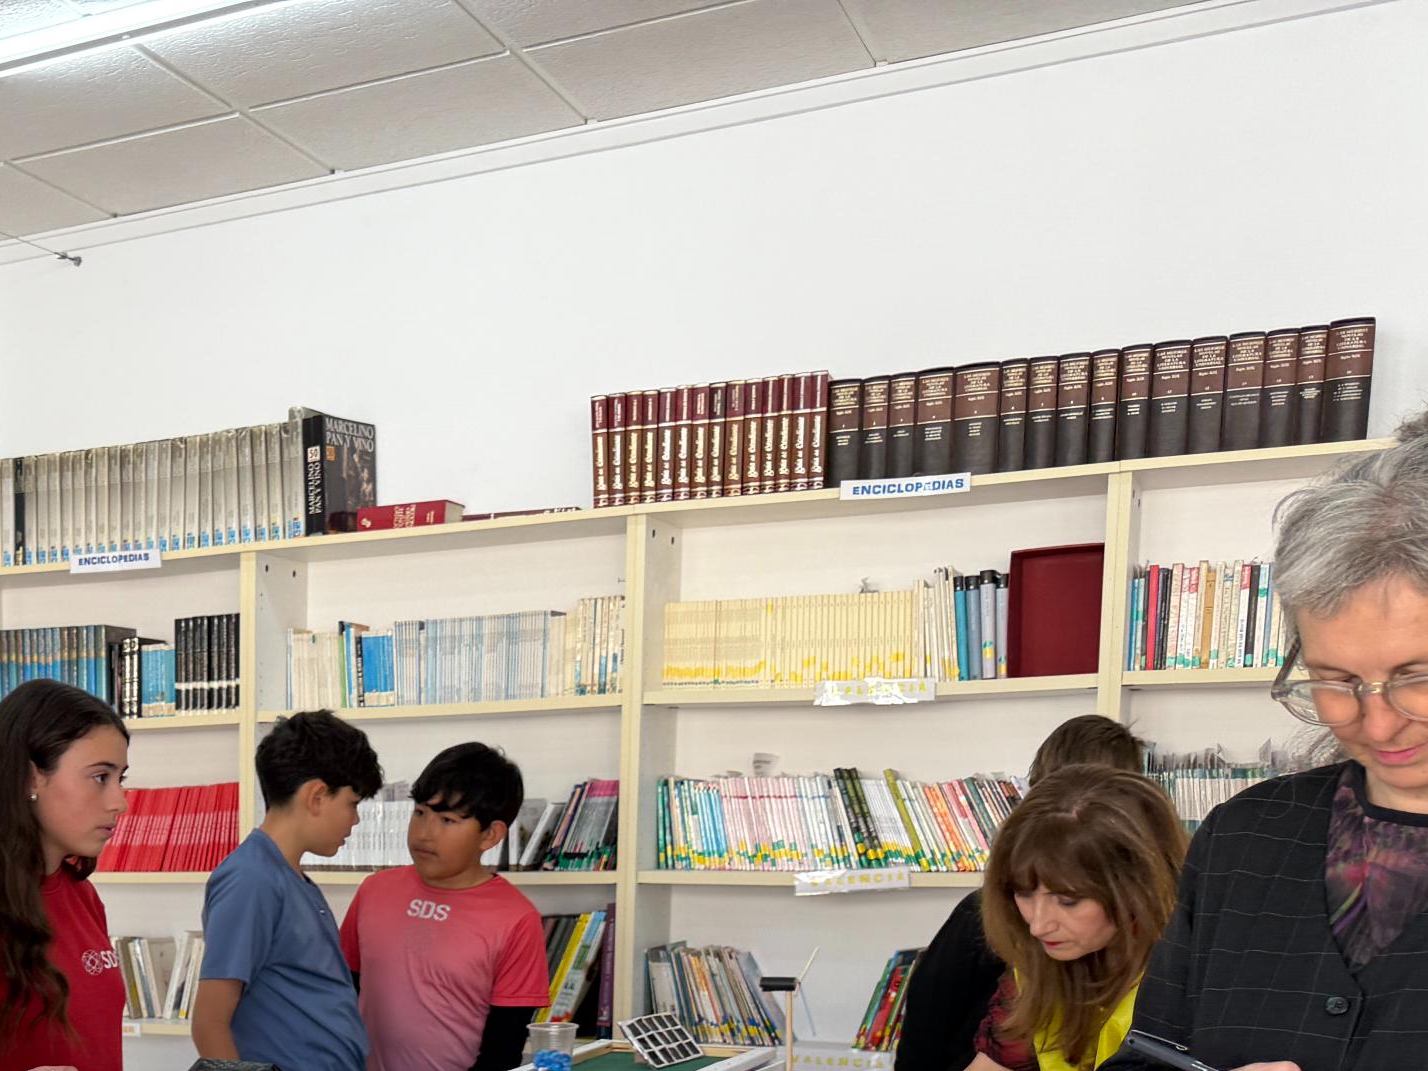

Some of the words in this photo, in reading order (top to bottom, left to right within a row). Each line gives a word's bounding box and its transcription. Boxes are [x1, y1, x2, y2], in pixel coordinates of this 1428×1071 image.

[325, 417, 374, 439] MARCELINO
[325, 431, 343, 447] PAN
[343, 437, 350, 448] Y
[352, 436, 374, 452] VINO
[852, 478, 964, 495] ENCICLOPEDIAS
[78, 552, 150, 567] ENCICLOPEDIAS
[407, 898, 451, 922] SDS
[100, 950, 119, 969] SD
